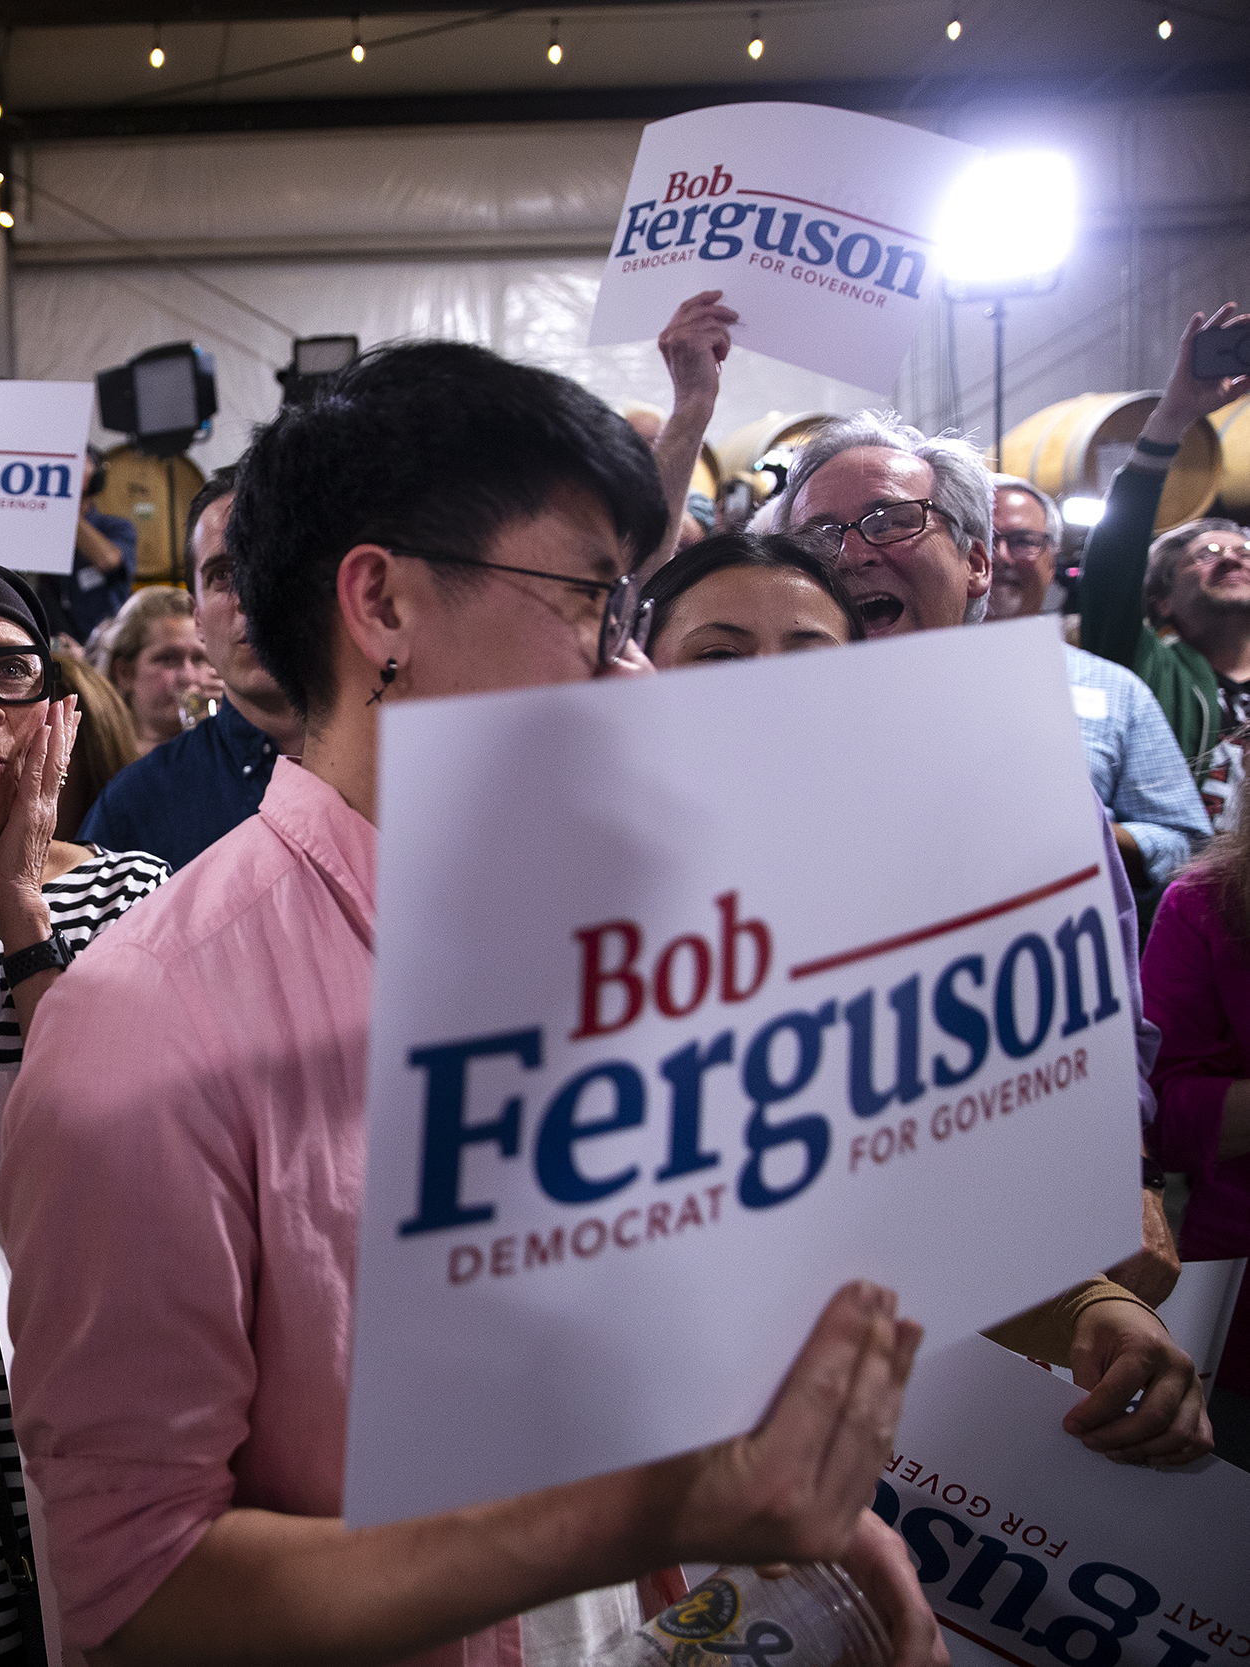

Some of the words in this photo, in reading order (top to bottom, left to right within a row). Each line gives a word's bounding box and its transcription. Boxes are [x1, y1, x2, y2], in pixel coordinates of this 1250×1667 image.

[662, 164, 733, 204] Bob
[615, 199, 928, 300] Ferguson
[621, 250, 695, 273] DEMOCRAT
[749, 253, 784, 275] FOR
[790, 266, 888, 308] GOVERNOR
[570, 889, 773, 1042] Bob
[398, 906, 1120, 1239] Ferguson
[448, 1184, 726, 1286] DEMOCRAT
[849, 1118, 919, 1174] FOR
[930, 1047, 1089, 1142] GOVERNOR
[1000, 1512, 1069, 1560] FOR
